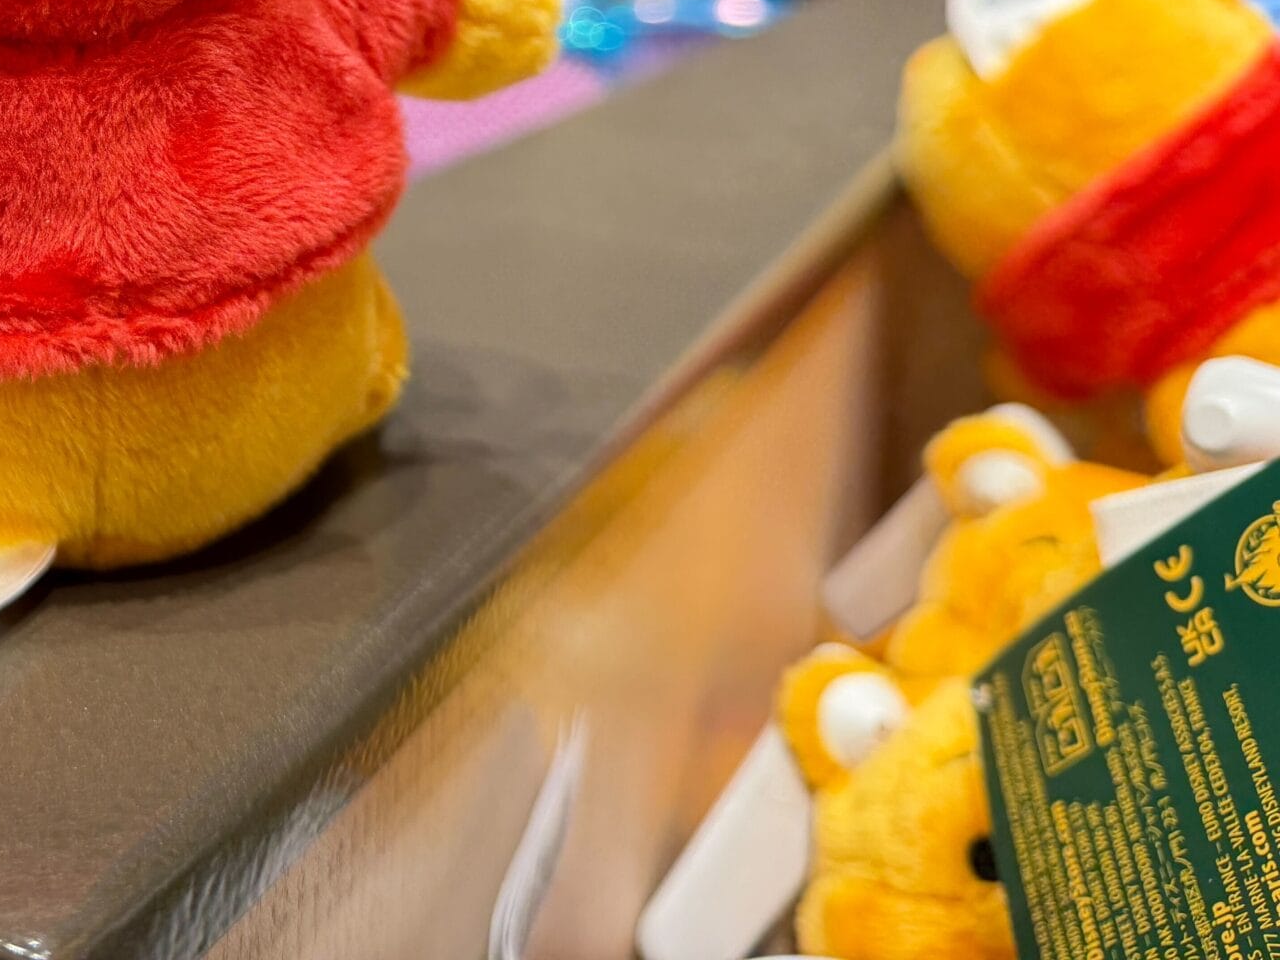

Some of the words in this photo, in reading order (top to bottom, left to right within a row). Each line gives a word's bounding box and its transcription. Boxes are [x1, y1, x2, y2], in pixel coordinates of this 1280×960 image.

[1183, 752, 1209, 802] DISNEY
[1241, 737, 1280, 825] DISNEYLAND
[1199, 801, 1222, 841] EURO
[1216, 853, 1244, 911] FRANCE
[1236, 912, 1251, 933] EN
